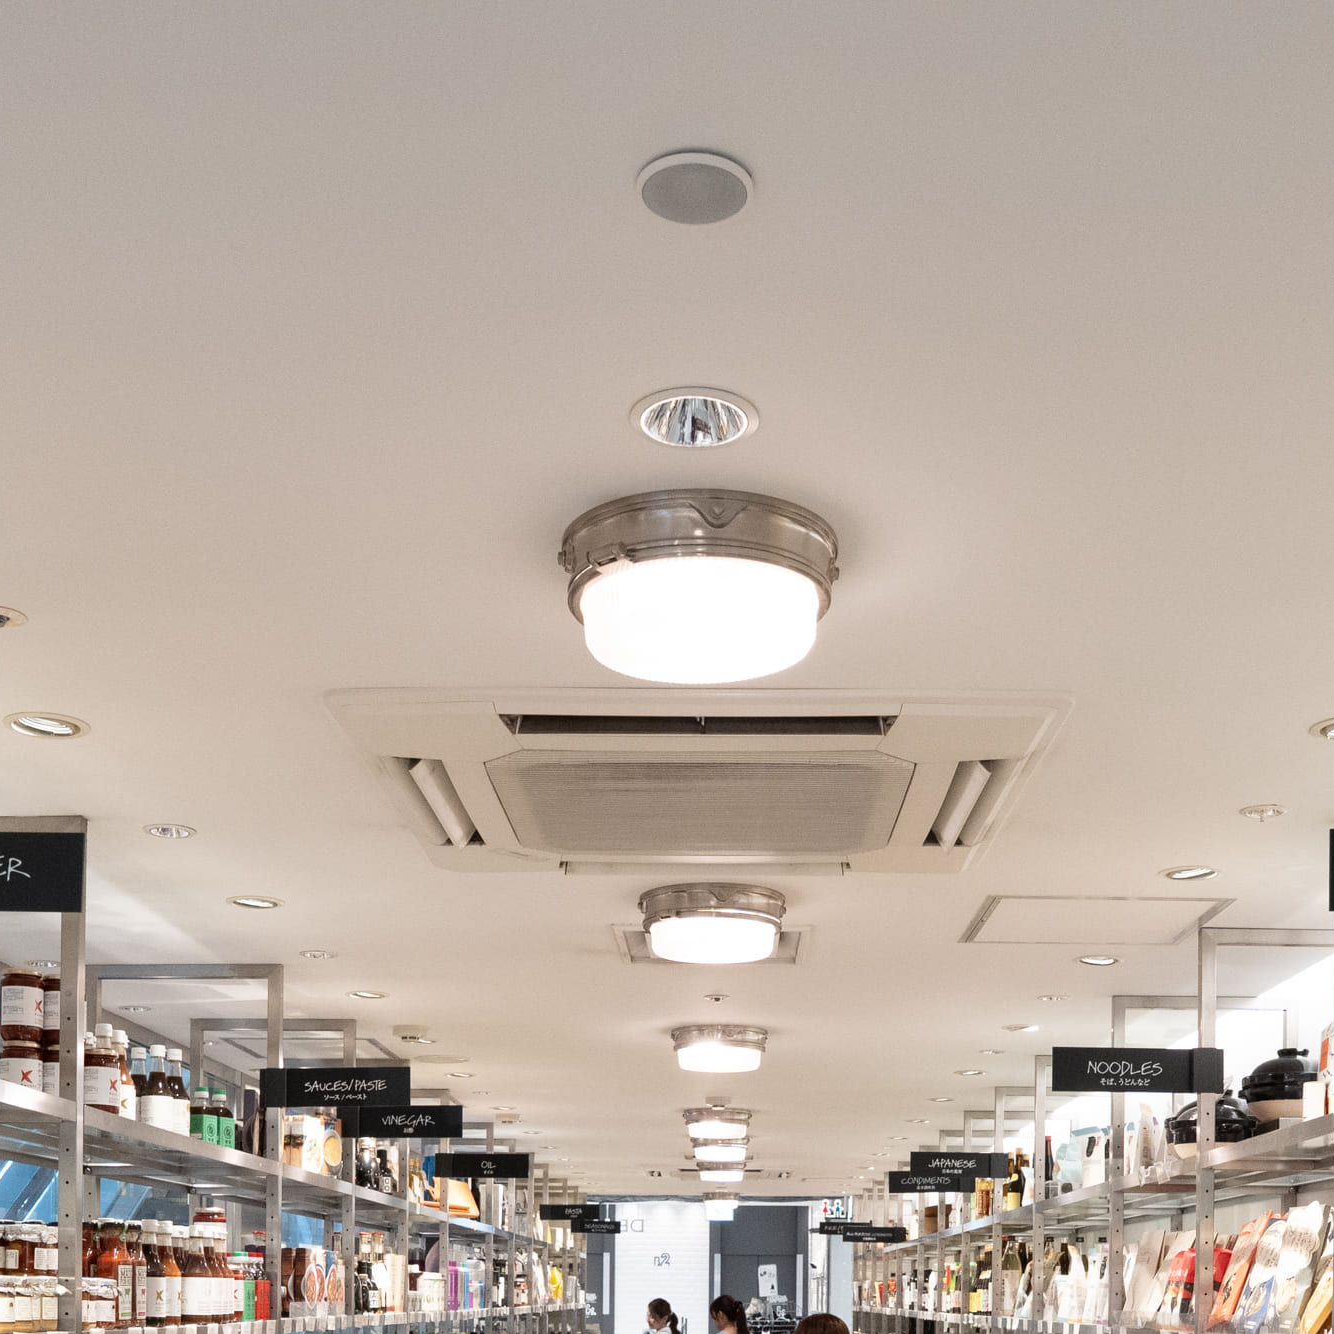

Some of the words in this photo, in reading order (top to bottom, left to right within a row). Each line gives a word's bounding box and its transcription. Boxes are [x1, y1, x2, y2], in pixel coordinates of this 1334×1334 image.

[1086, 1060, 1164, 1077] NOODLES
[380, 1113, 436, 1127] VINEGAR
[480, 1160, 497, 1170] OIL
[927, 1158, 978, 1169] JAPANESE
[900, 1176, 951, 1185] CONDIMENTS
